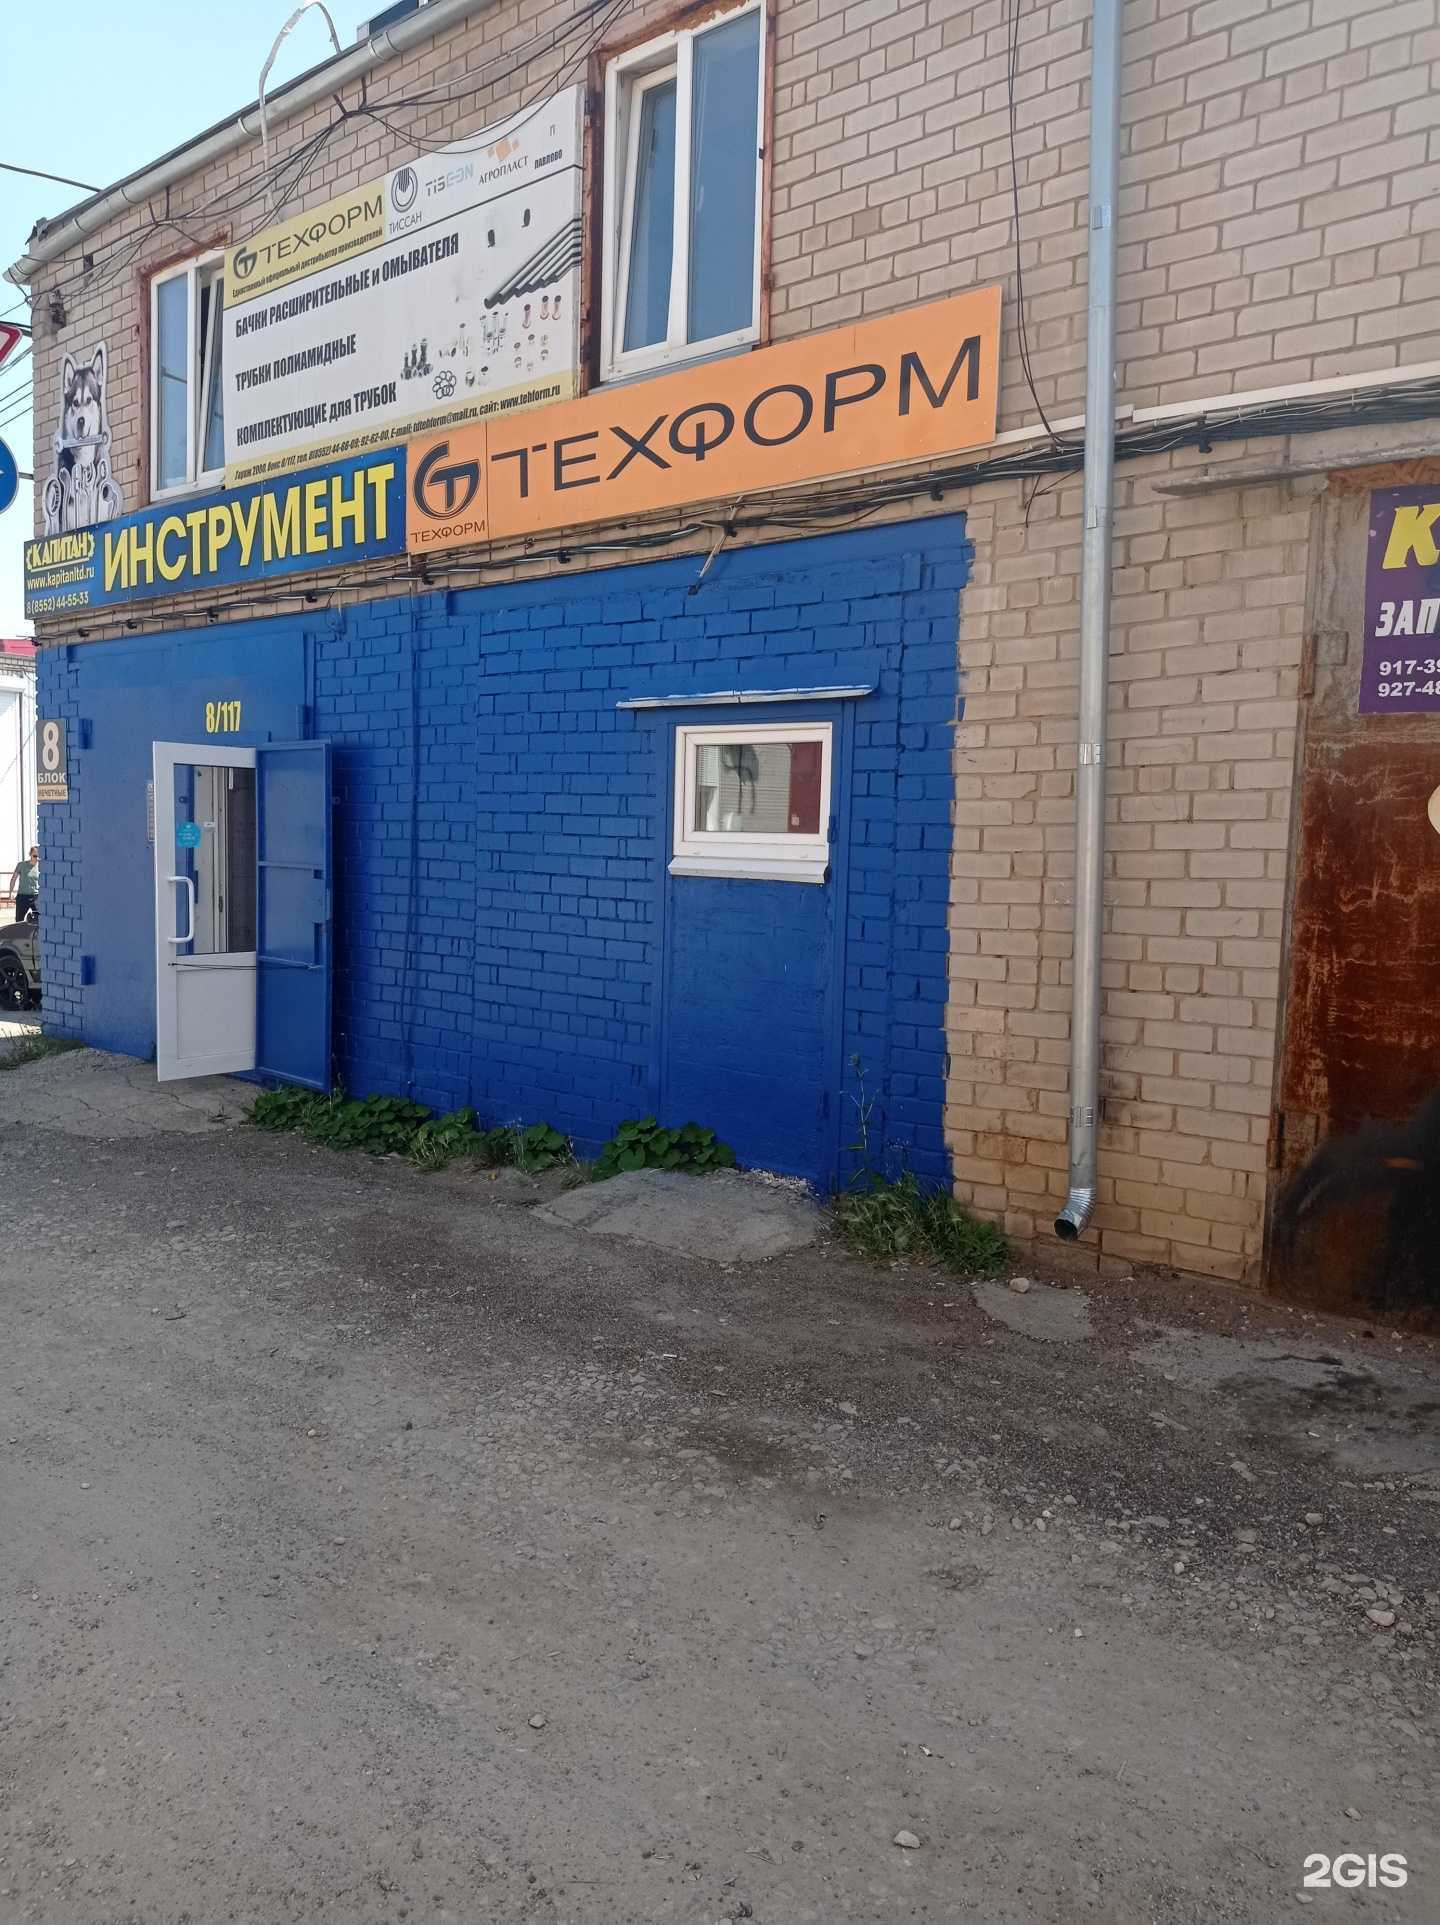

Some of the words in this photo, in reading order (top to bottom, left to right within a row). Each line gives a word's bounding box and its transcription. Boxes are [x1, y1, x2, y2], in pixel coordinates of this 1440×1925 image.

[478, 155, 529, 185] АГРОПЛАСТ
[534, 149, 563, 169] ПАВЛОВО
[259, 195, 383, 264] ТЕХФОРМ
[389, 211, 422, 234] ТИССАН
[300, 247, 337, 270] дистрибьютор
[338, 226, 383, 254] производителей
[236, 308, 268, 338] БАЧКИ
[269, 269, 370, 325] РАСШИРИТЕЛЬНЫЕ
[382, 232, 459, 282] ОМЫВАТЕЛЯ
[235, 365, 271, 392] ТРУБКИ
[273, 334, 356, 379] ПОЛИАМИДНЫЕ
[237, 403, 327, 446] КОМПЛЕКТУЮЩИЕ
[353, 381, 397, 413] ТРУБОК
[480, 401, 499, 415] сайт:
[500, 384, 561, 410] www.tehform.ru
[491, 335, 982, 498] ТЕХФОРМ
[104, 463, 395, 592] ИНСТРУМЕНТ
[410, 519, 487, 544] ТЕХФОРМ
[31, 532, 88, 568] КАПИТАН
[27, 564, 95, 590] www.kapitanltd.ru
[56, 591, 89, 609] 44-55-33
[205, 700, 241, 733] 8/117
[42, 721, 60, 771] 8
[38, 772, 67, 784] БЛОК
